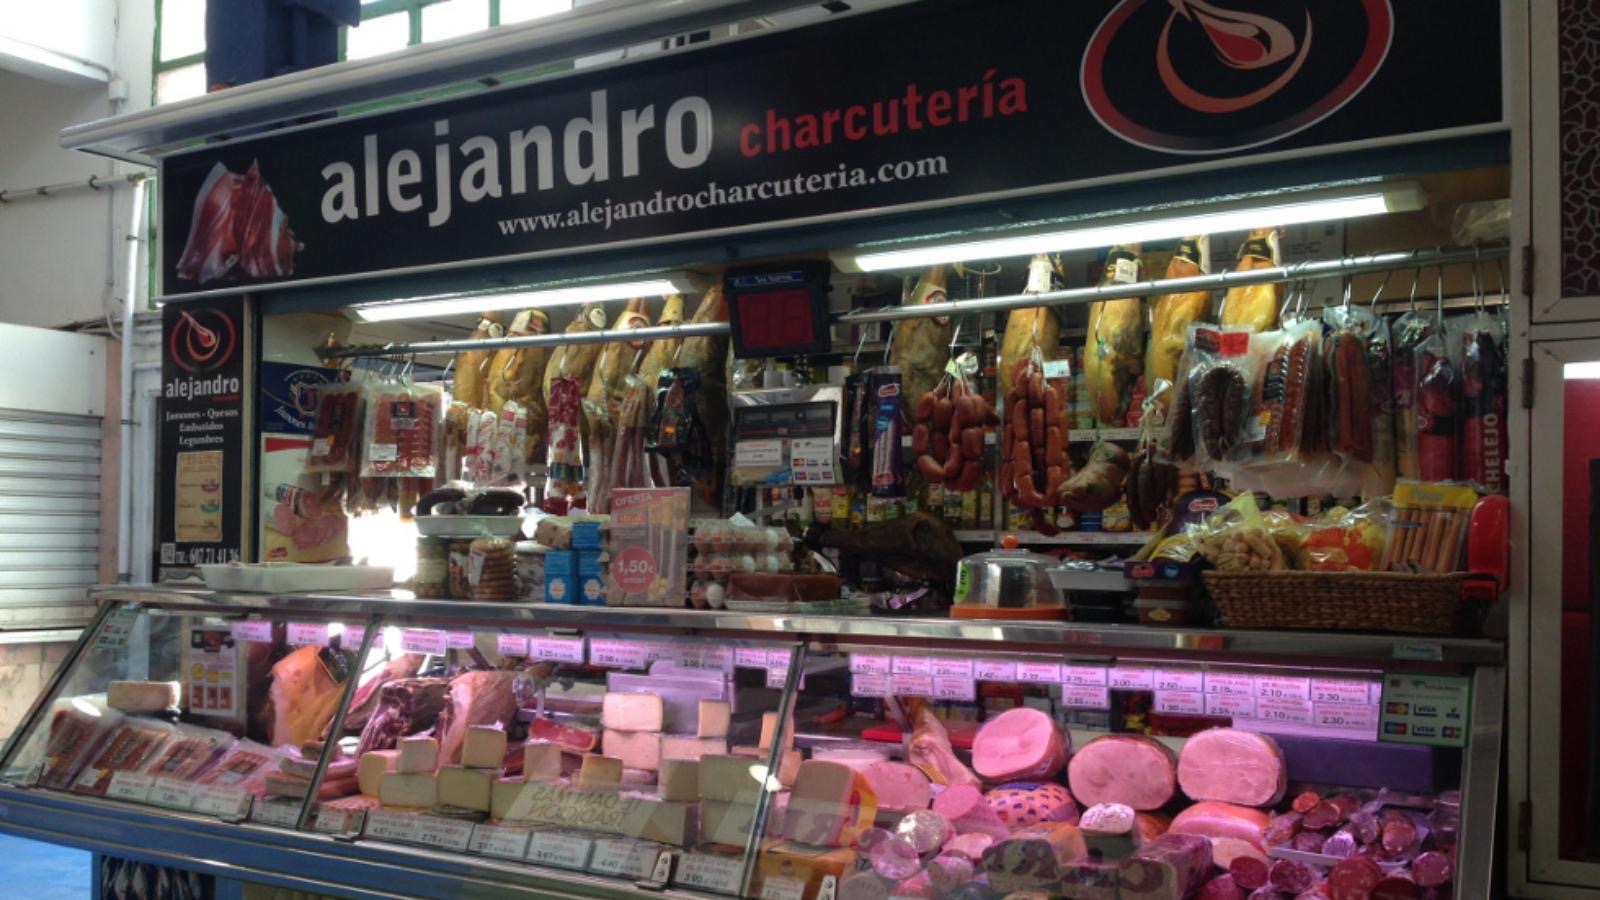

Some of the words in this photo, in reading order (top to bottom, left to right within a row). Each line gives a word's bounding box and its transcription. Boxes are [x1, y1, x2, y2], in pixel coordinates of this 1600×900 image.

[320, 89, 713, 228] alejandro
[740, 67, 1028, 158] charcutería
[498, 154, 949, 236] www.alejandrocharcuteria.com
[165, 373, 240, 401] alejandro
[207, 408, 239, 420] Quesos
[179, 422, 224, 433] Embutidos
[179, 435, 224, 448] Legumbres
[615, 492, 654, 507] OFERTA
[617, 559, 655, 576] 1,50€
[1260, 688, 1283, 698] 2.10
[1264, 710, 1286, 719] 2.10
[1322, 716, 1344, 725] 2.30
